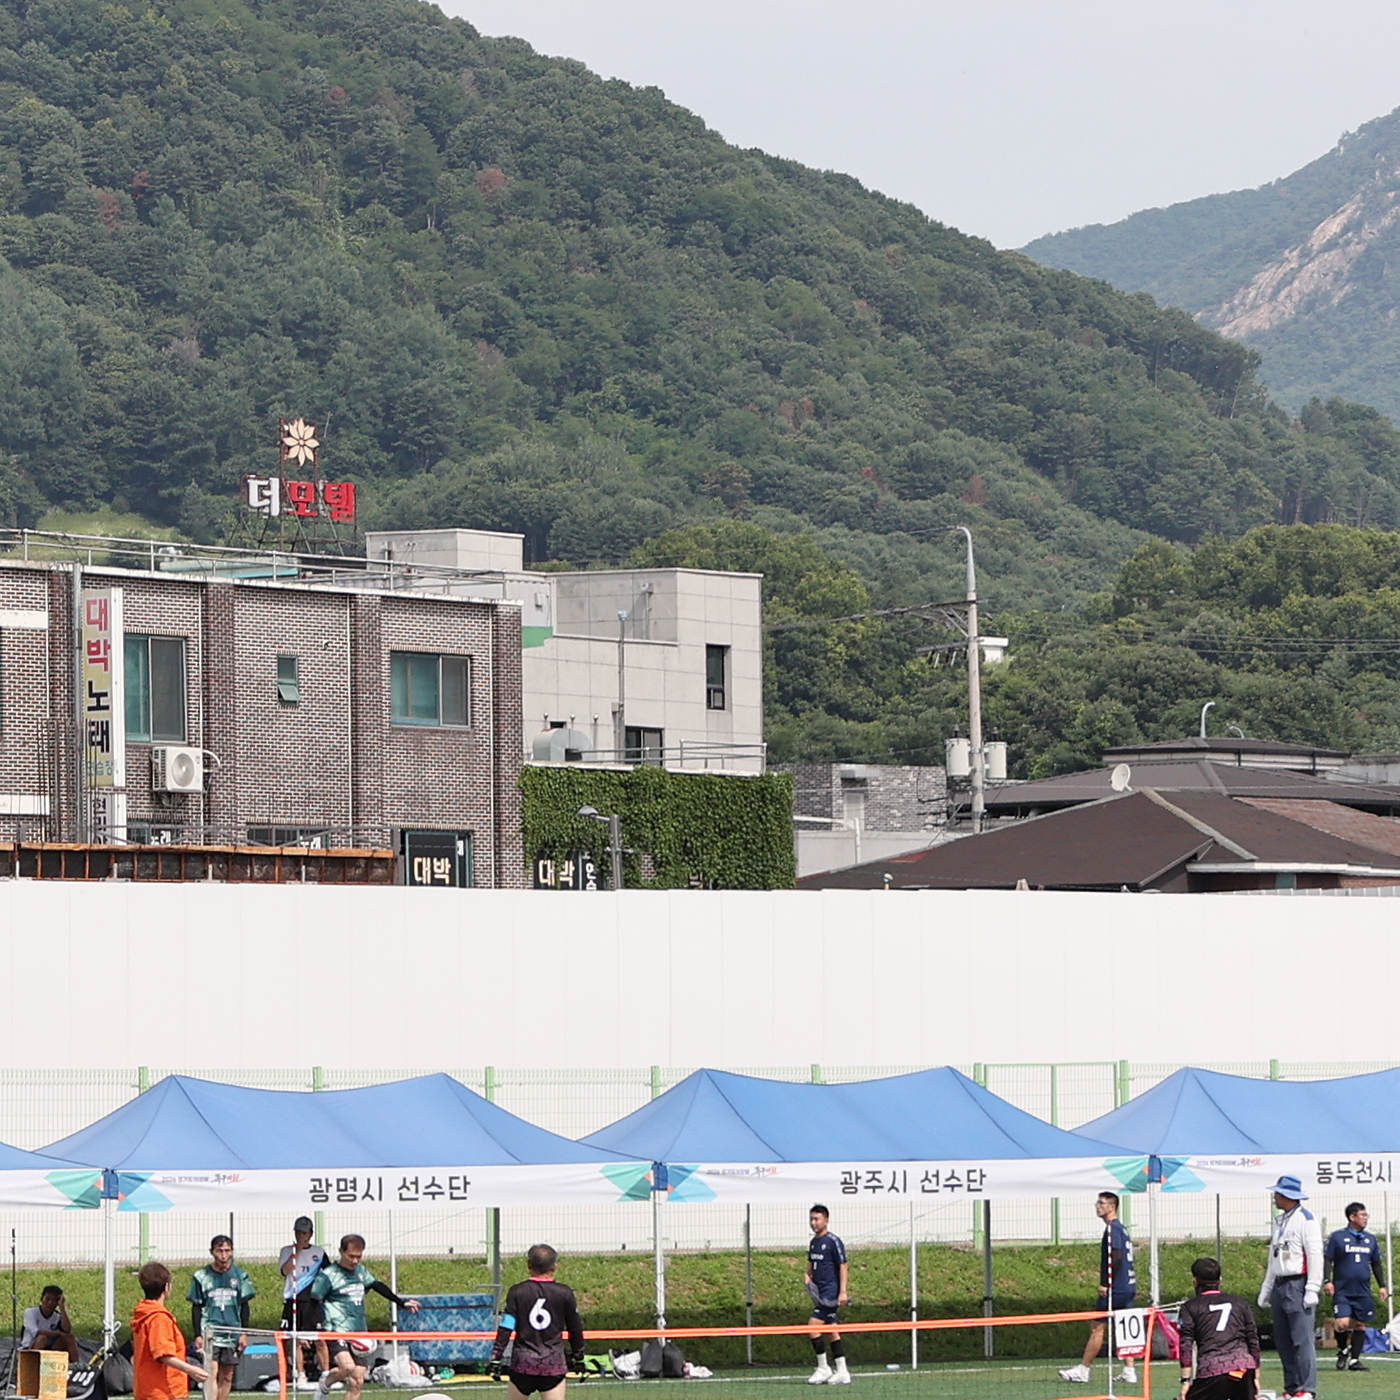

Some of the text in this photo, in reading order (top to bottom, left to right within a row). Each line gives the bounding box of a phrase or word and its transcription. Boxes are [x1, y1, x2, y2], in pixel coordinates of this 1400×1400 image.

[414, 857, 450, 884] 대박
[840, 1168, 987, 1195] 광주시 선수단
[1316, 1159, 1392, 1185] 동두천시
[309, 1175, 471, 1203] 광명시 선수단
[528, 1297, 552, 1331] 6
[1208, 1302, 1233, 1332] 7
[1119, 1315, 1141, 1341] 10
